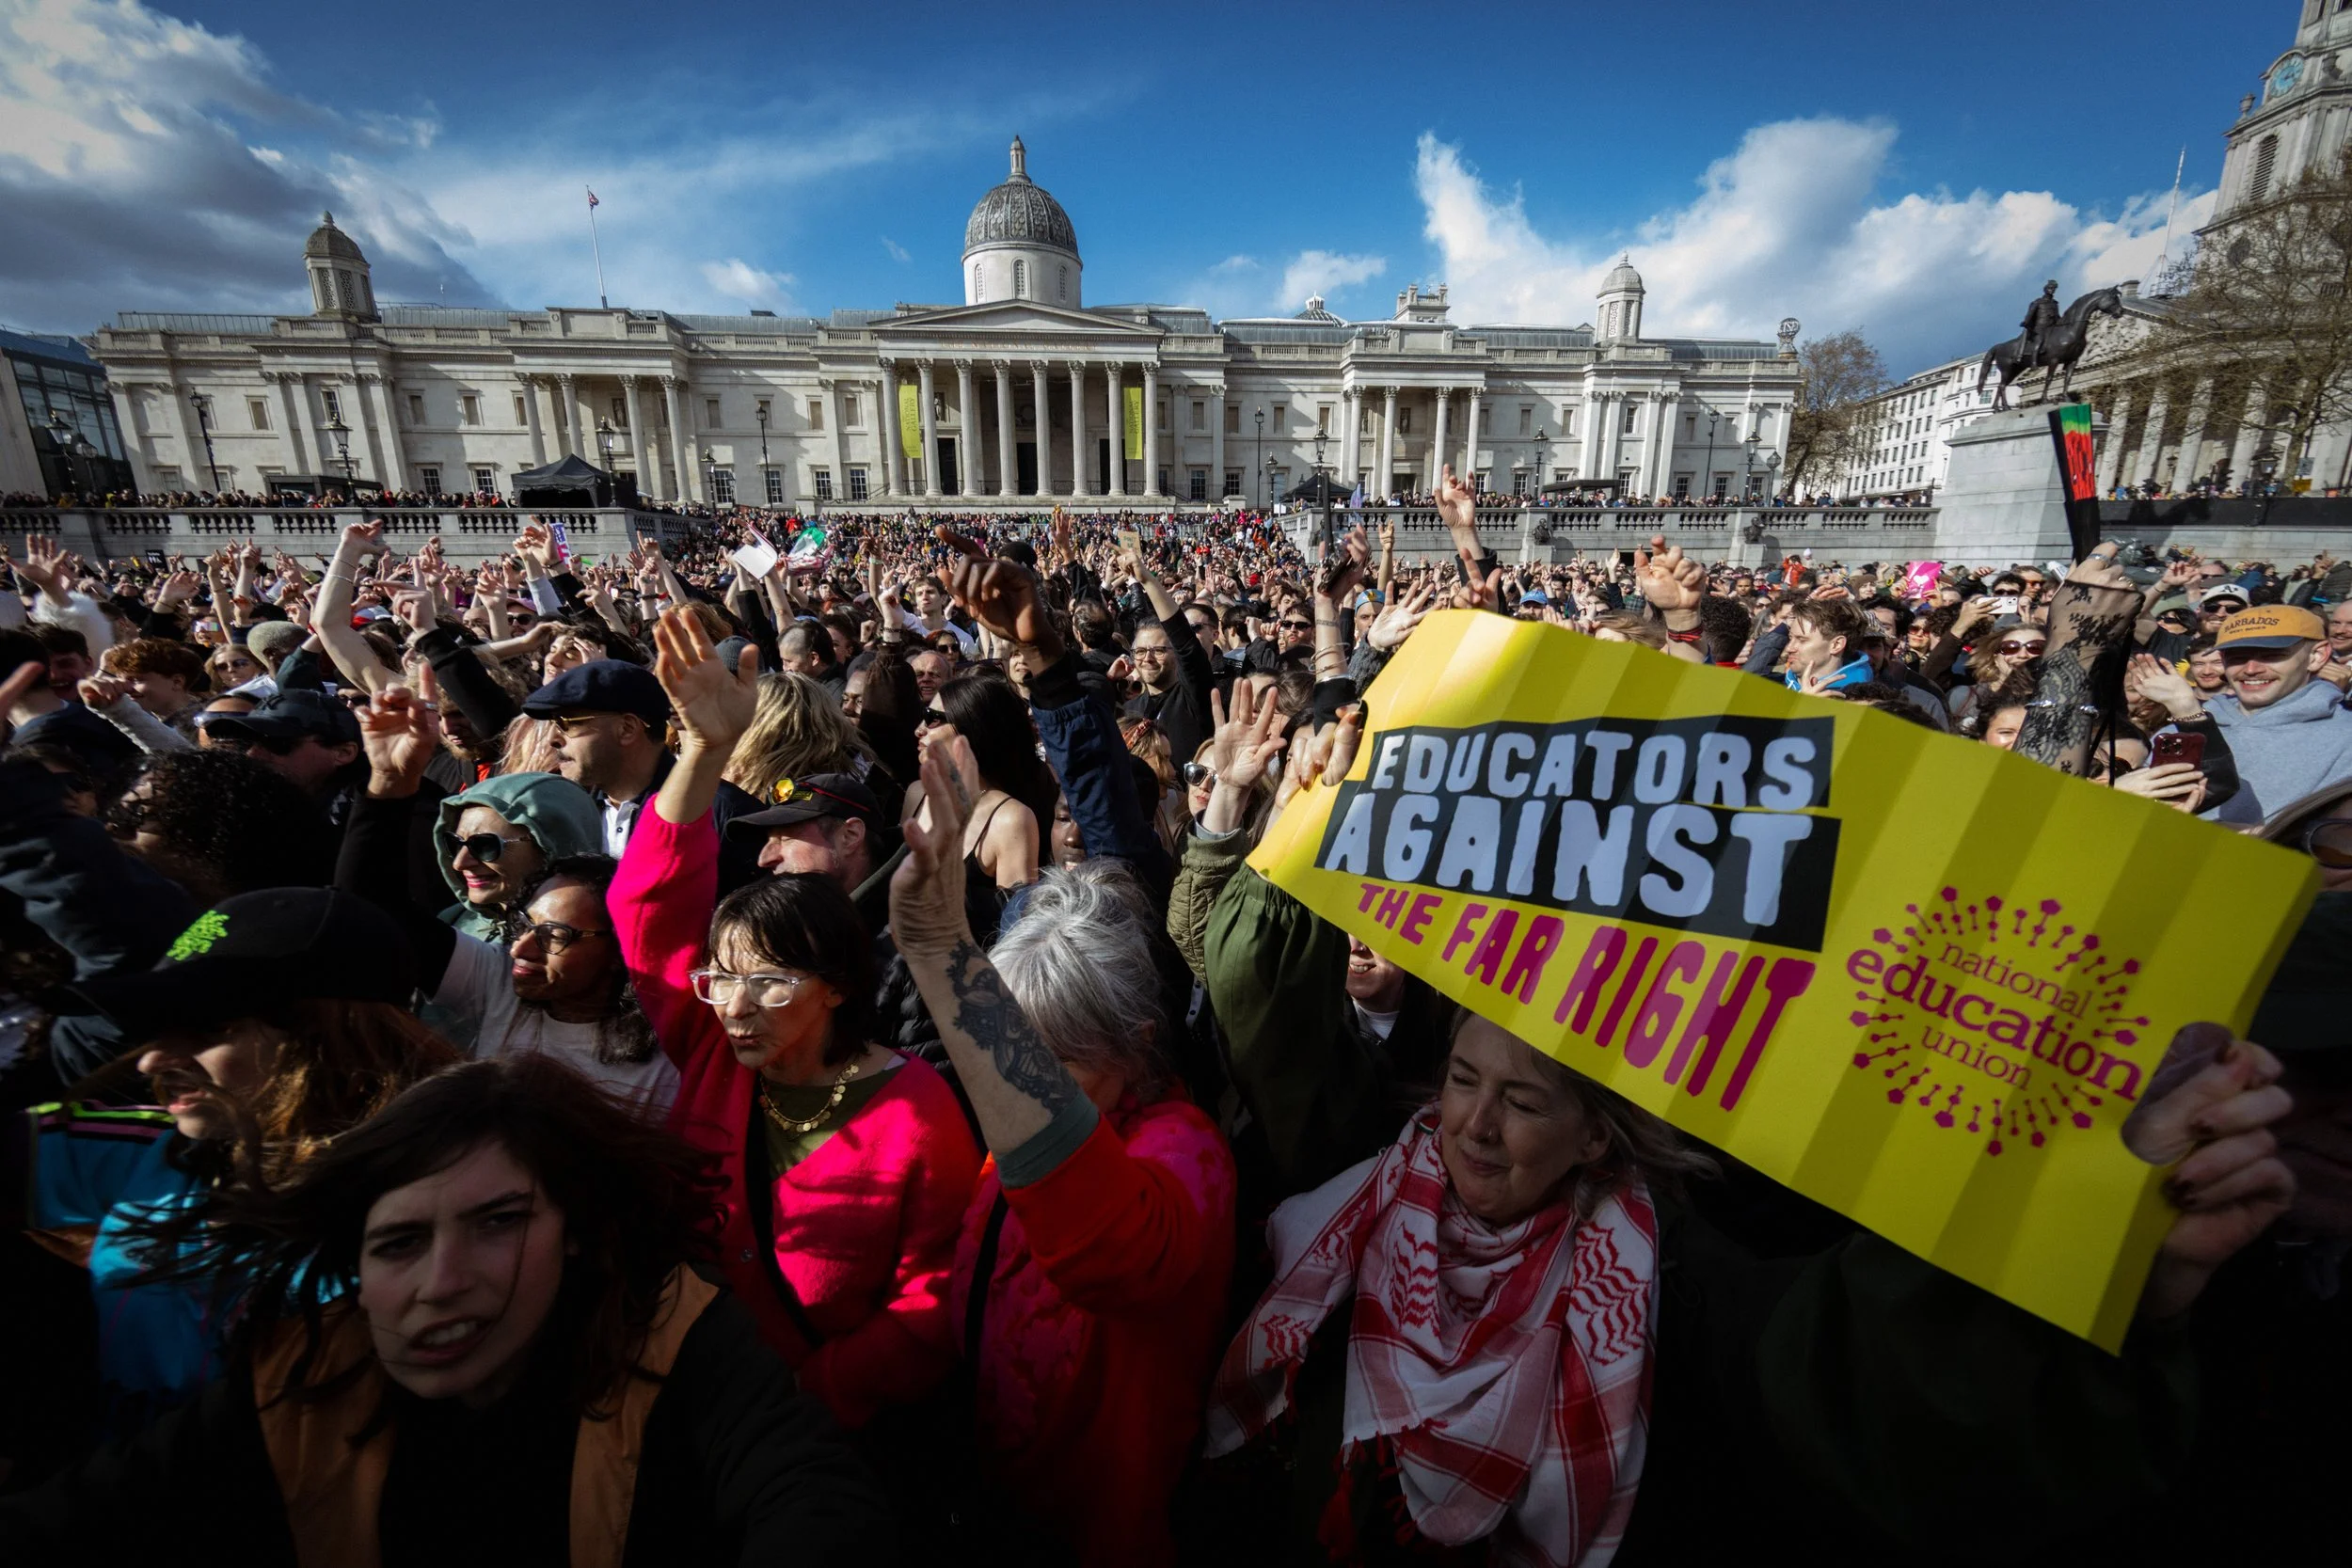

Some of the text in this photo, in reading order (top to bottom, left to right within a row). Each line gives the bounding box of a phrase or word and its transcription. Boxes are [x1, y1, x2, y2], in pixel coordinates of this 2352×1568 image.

[903, 398, 912, 431] NATIONAL
[909, 397, 917, 432] GALLERY
[2224, 616, 2280, 633] BARBADOS
[1372, 732, 1816, 811] EDUCATORS
[1325, 793, 1812, 927] AGAINST
[1358, 883, 1816, 1111] THE FAR RIGHT
[1938, 942, 2092, 1020] national
[1847, 949, 2143, 1101] education
[1921, 1026, 2032, 1091] union
